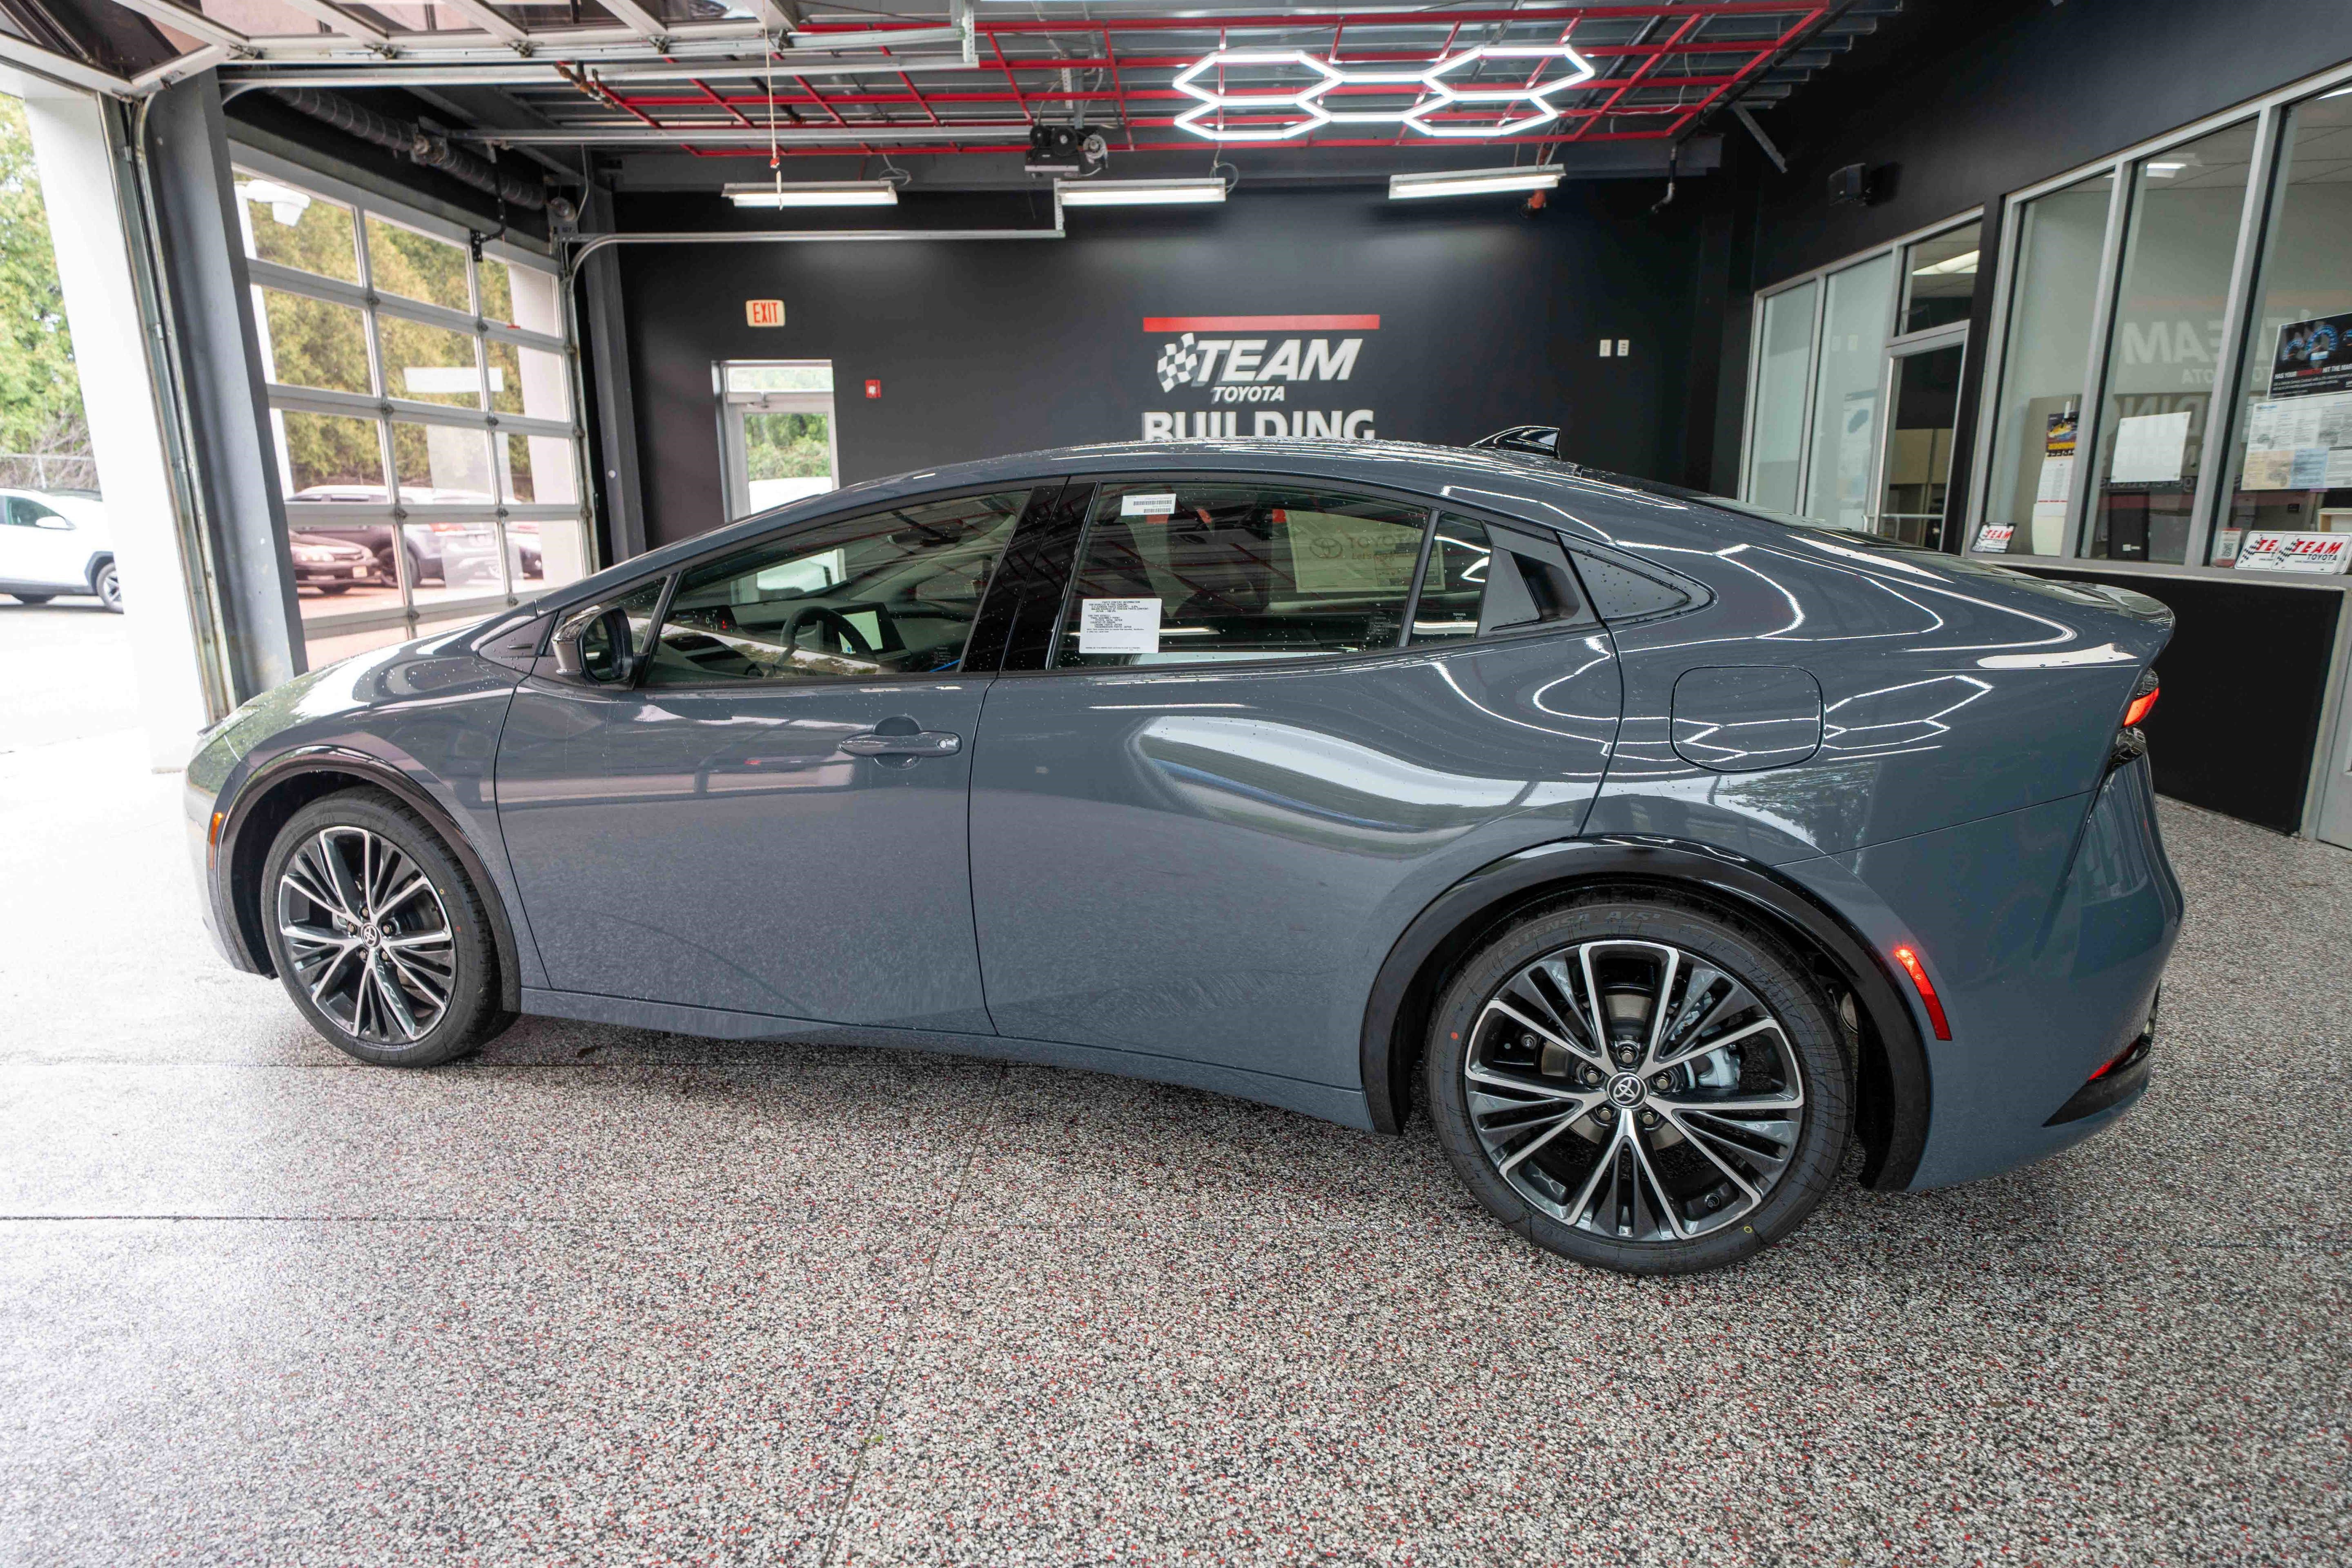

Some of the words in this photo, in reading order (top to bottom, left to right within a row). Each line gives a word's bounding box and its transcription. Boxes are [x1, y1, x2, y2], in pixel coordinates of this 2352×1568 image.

[753, 302, 777, 323] EXIT
[1195, 339, 1363, 382] TEAM
[1213, 385, 1285, 403] TOYOTA
[1143, 410, 1374, 440] BUILDING
[1986, 530, 2013, 539] TEAM
[2290, 541, 2344, 554] TEAM
